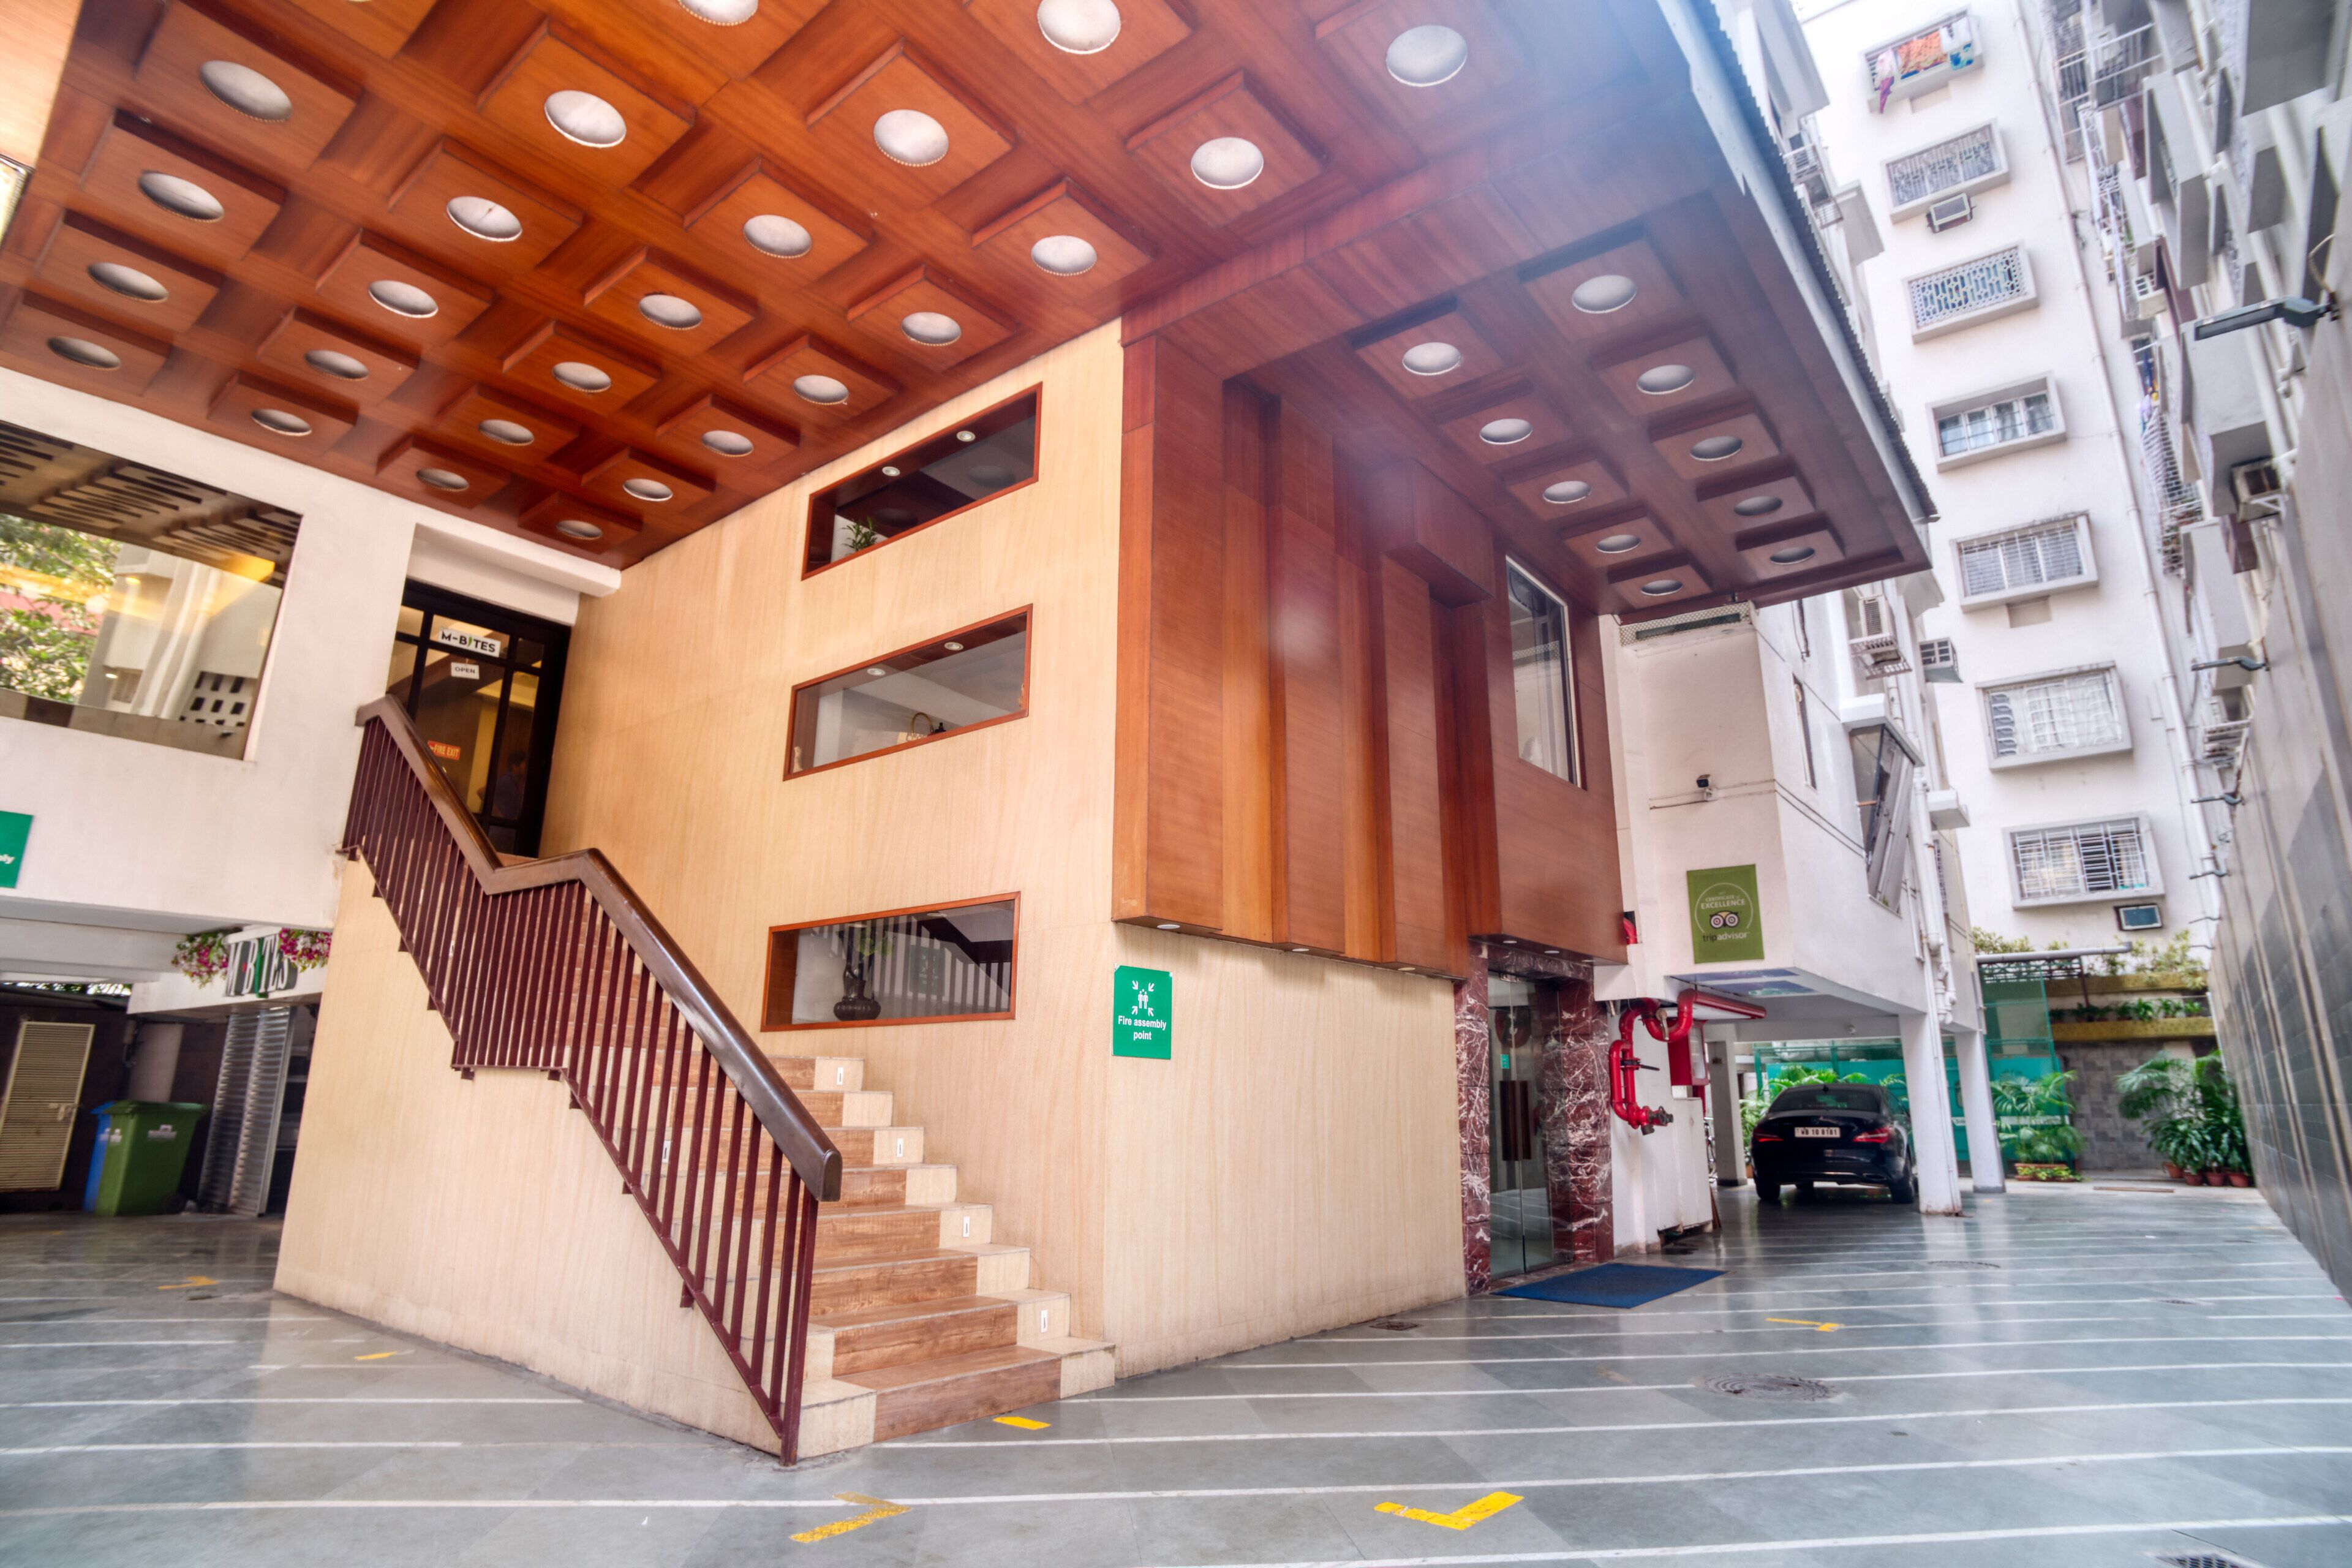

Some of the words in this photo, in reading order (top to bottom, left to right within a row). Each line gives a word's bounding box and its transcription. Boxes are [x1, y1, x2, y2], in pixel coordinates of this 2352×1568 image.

[454, 666, 475, 674] OPEN
[434, 744, 446, 755] FIRE
[447, 747, 459, 759] EXIT
[1700, 899, 1745, 910] EXCELLENCE
[1702, 931, 1748, 943] tripadvisor
[1118, 1016, 1132, 1026] Fire
[1134, 1019, 1167, 1030] assembly
[1133, 1031, 1152, 1041] point
